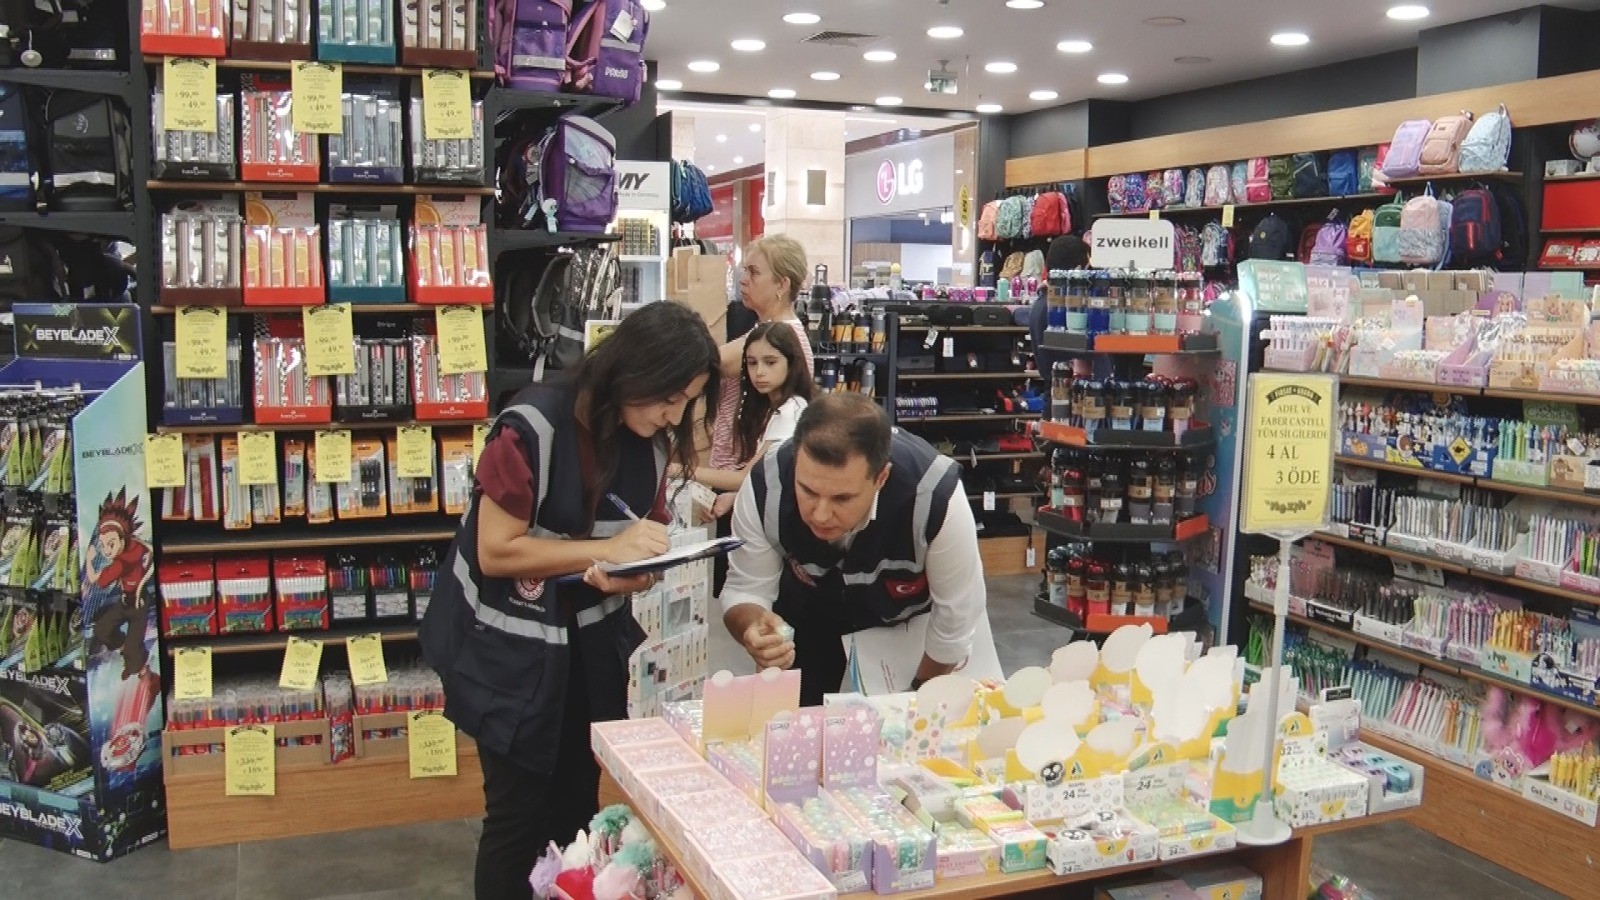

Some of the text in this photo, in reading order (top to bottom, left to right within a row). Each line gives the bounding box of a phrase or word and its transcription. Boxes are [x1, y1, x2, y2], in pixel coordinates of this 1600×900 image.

[618, 173, 650, 190] MY
[898, 159, 923, 195] LG
[1096, 236, 1169, 249] zweikell
[1260, 416, 1288, 426] FABER
[1266, 444, 1300, 460] 4 AL
[1275, 466, 1320, 485] 3 ÖDE
